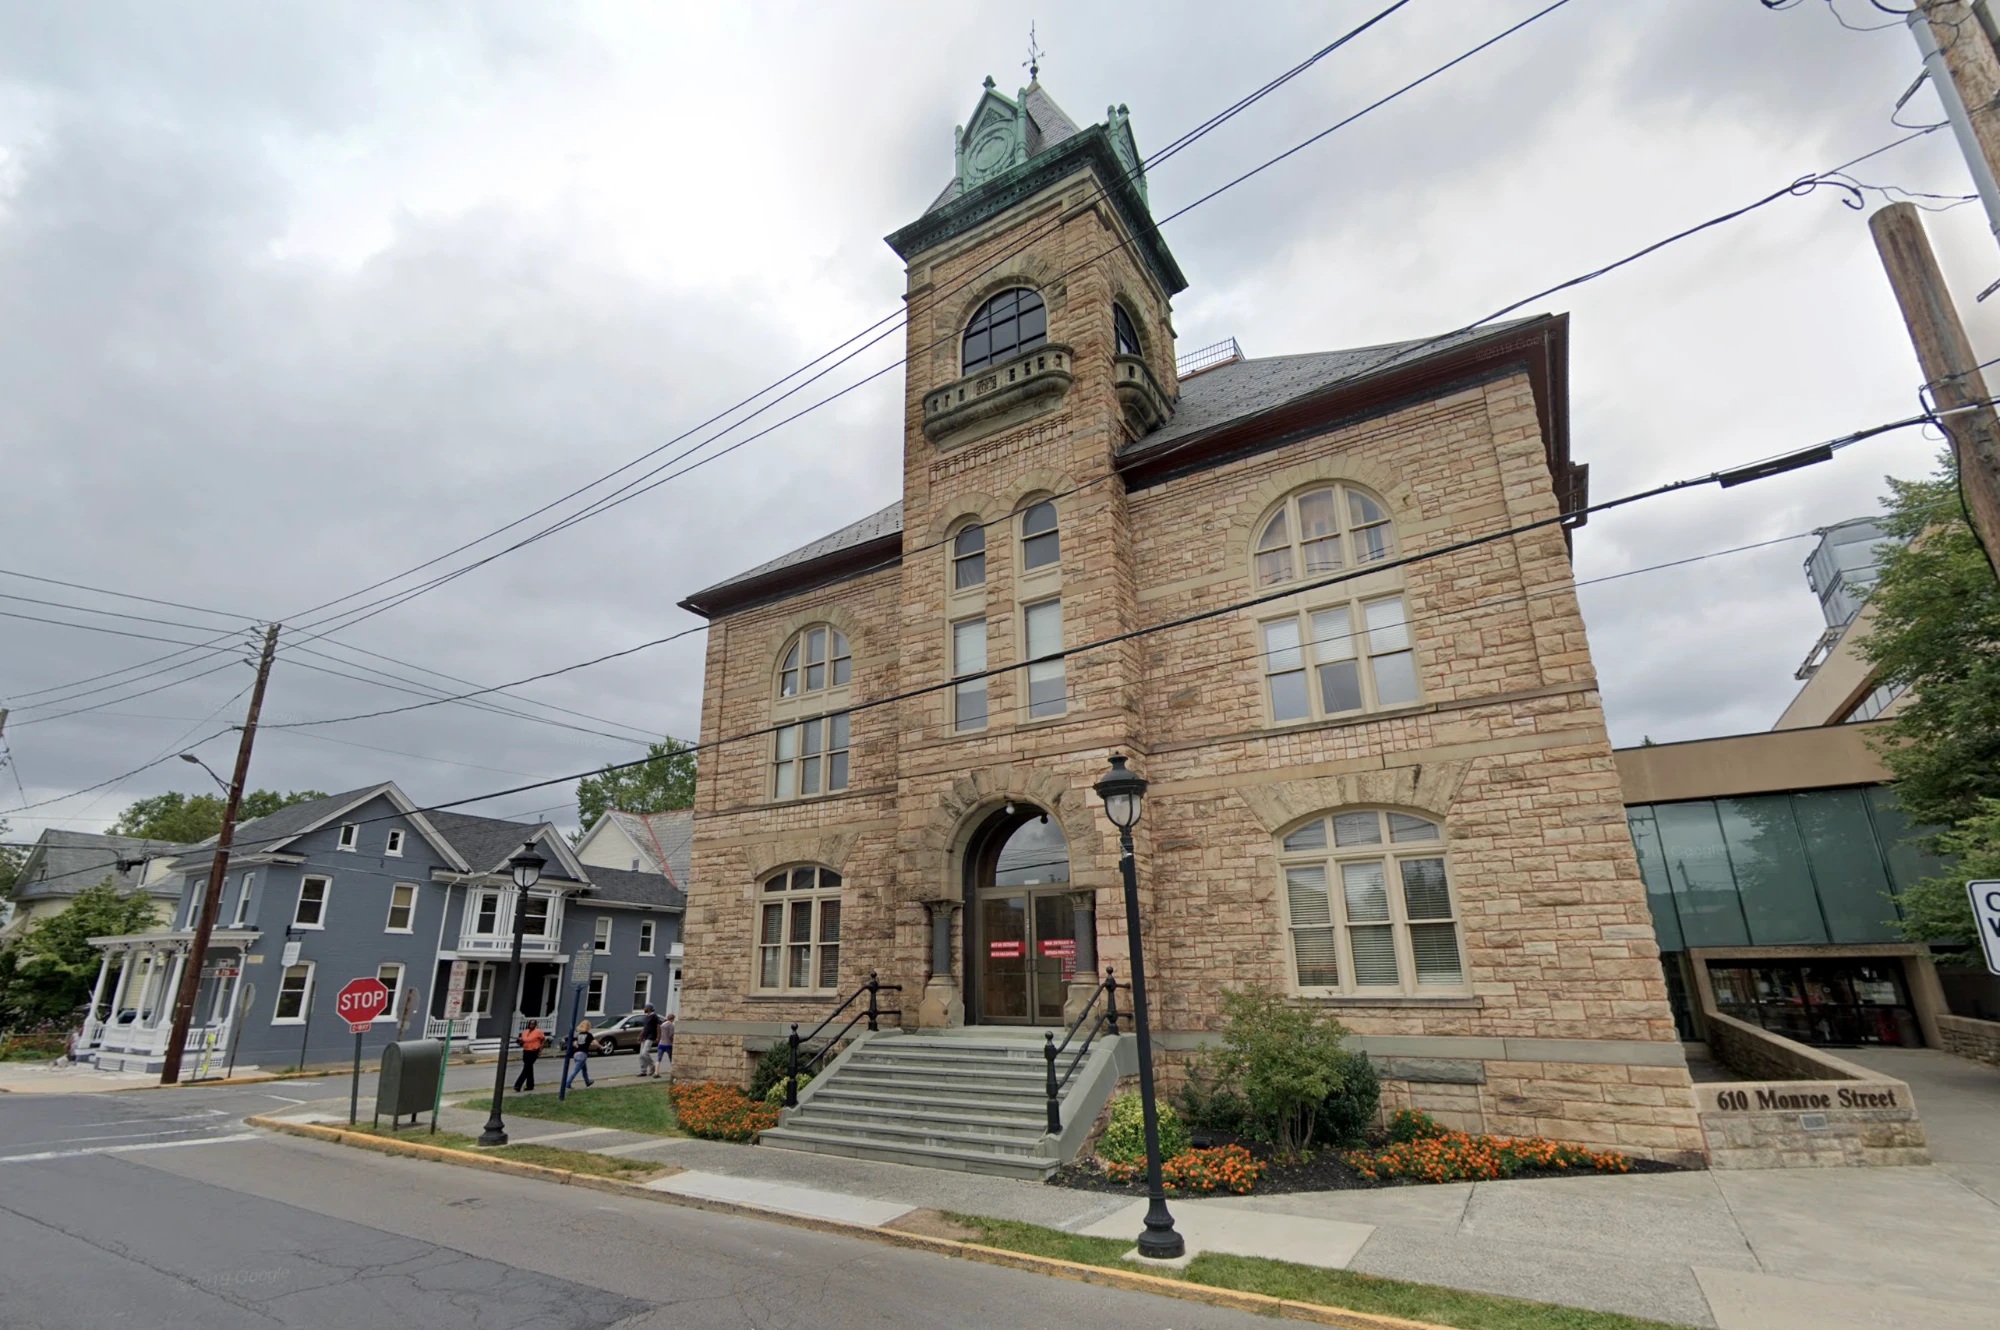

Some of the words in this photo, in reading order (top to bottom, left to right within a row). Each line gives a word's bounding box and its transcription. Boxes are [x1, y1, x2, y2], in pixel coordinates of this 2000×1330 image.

[340, 990, 385, 1011] STOP
[1716, 1090, 1748, 1111] 610
[1755, 1089, 1831, 1110] Monroe
[1838, 1088, 1897, 1109] Street
